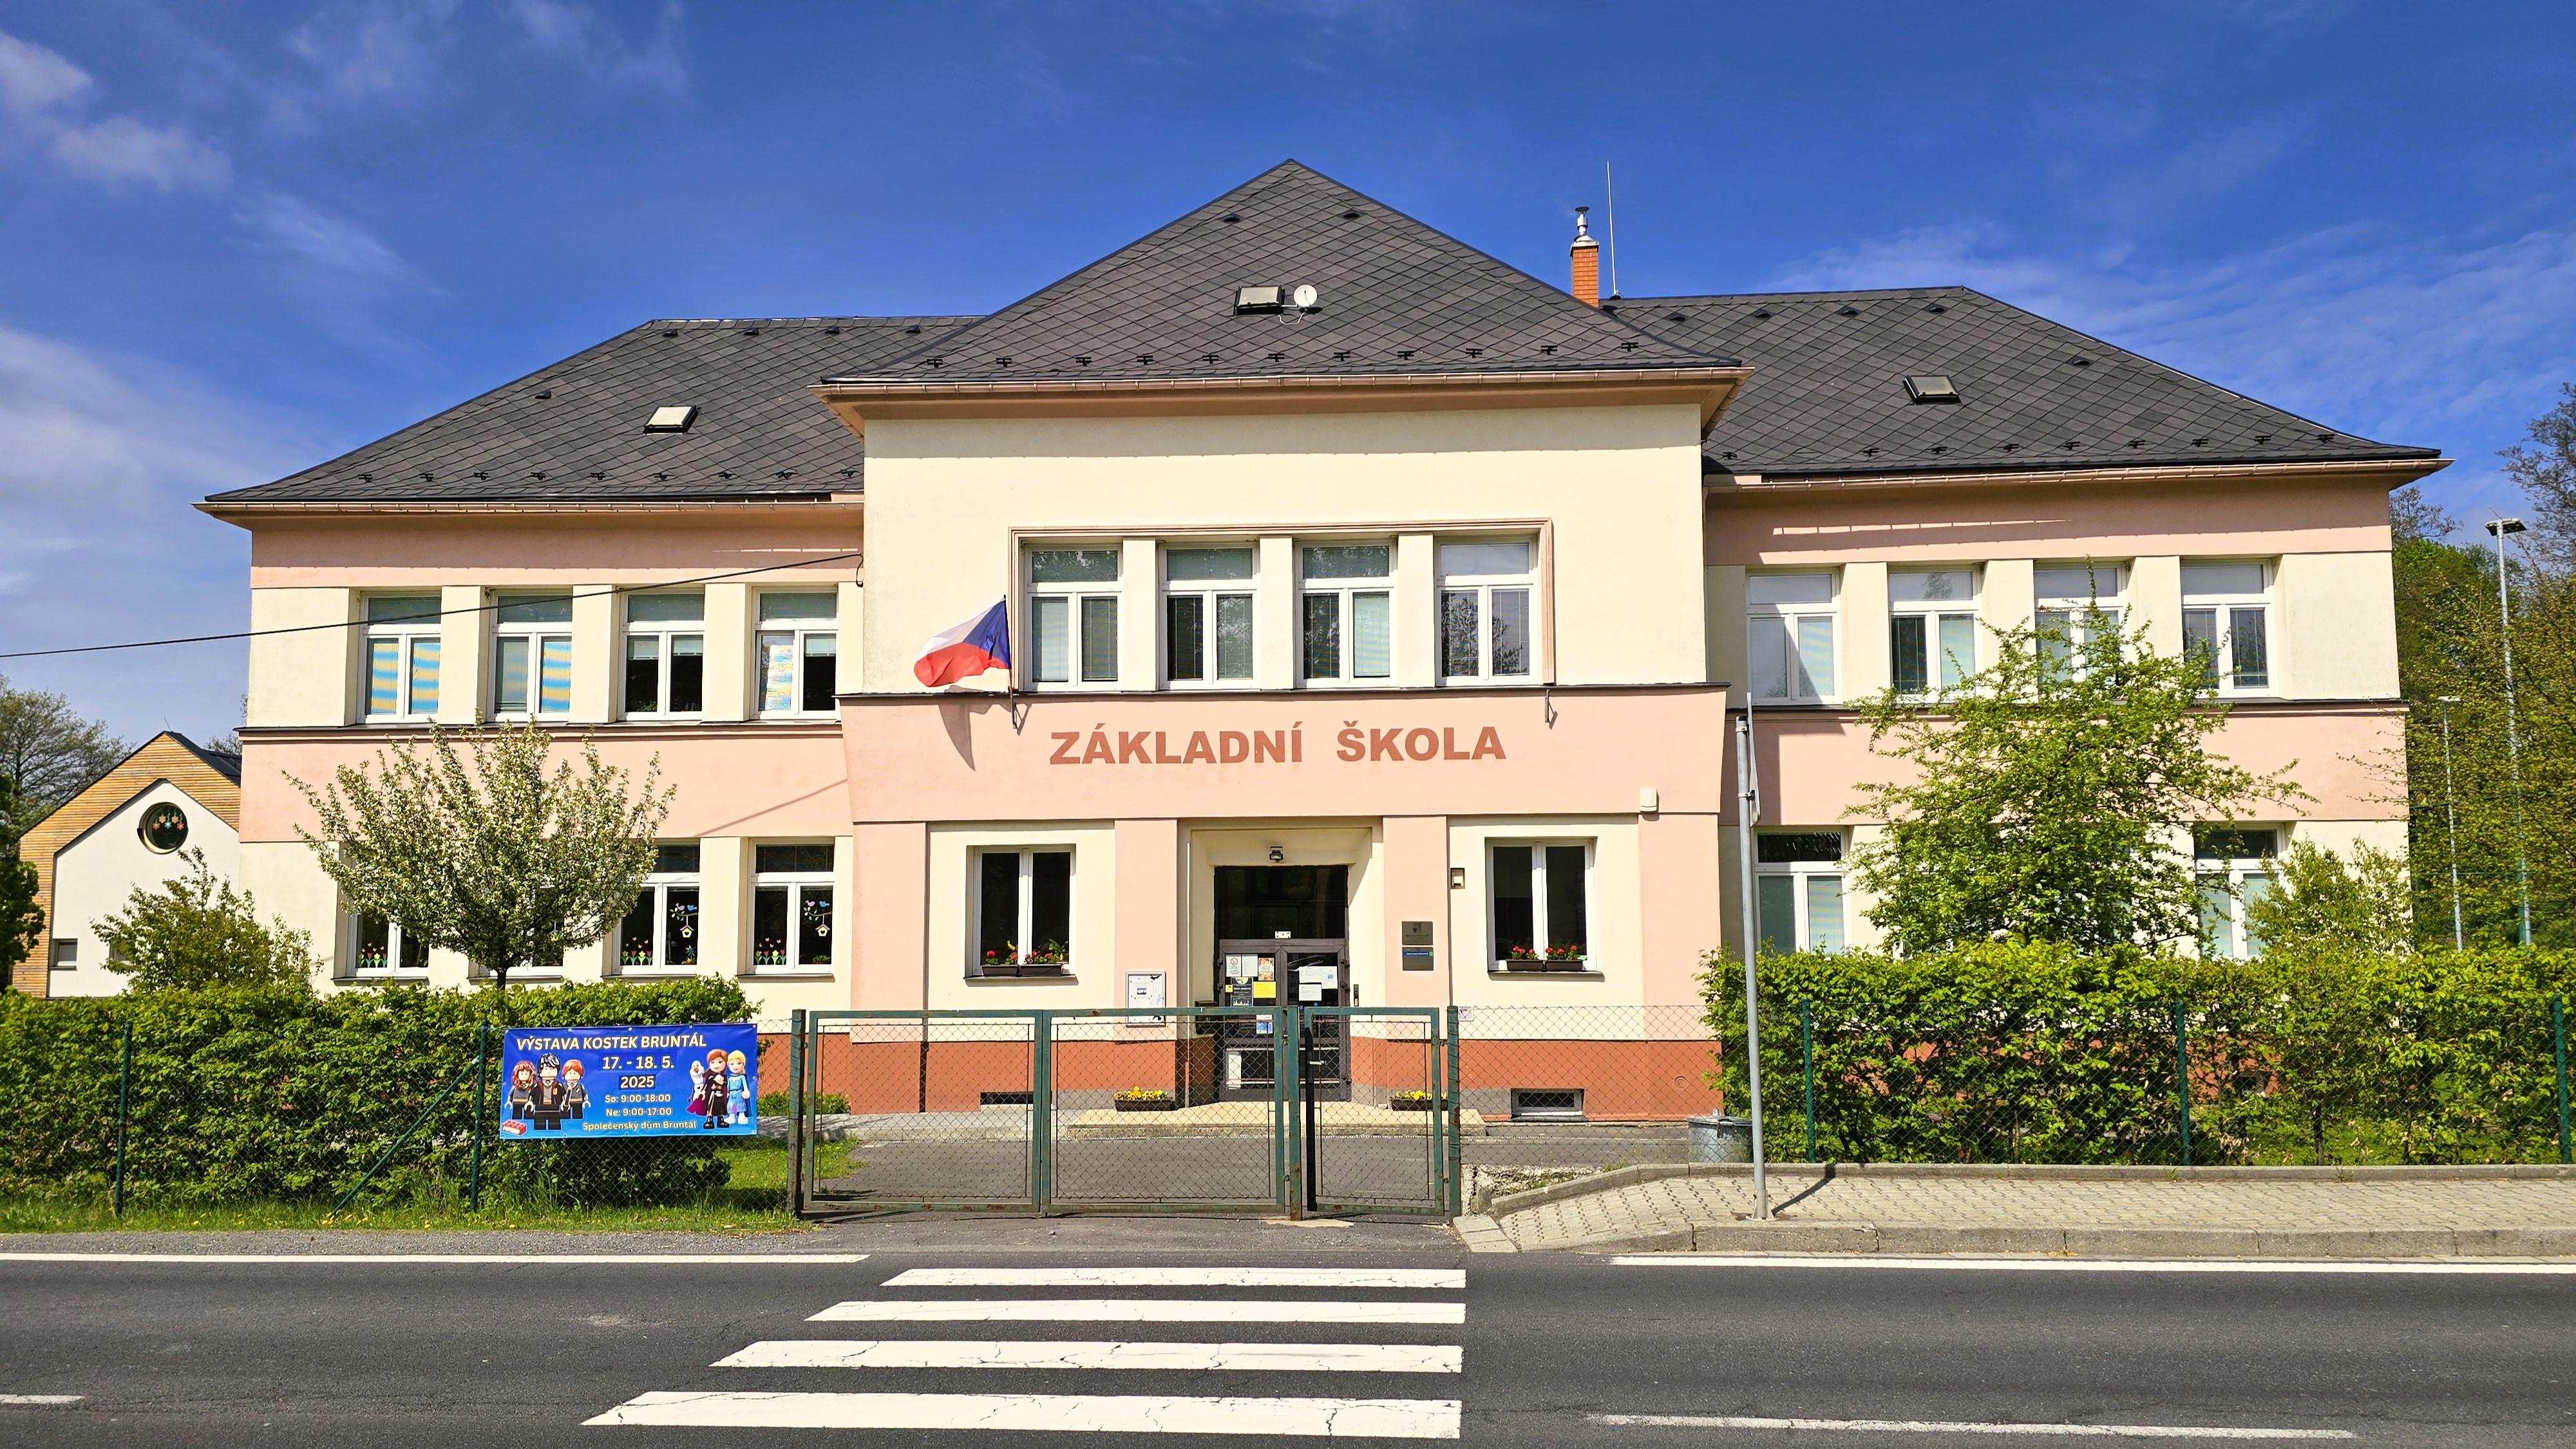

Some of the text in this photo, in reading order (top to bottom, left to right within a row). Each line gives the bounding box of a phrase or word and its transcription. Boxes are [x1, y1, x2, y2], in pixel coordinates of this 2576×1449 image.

[1050, 720, 1507, 765] ZÁKLADNÍ ŠKOLA
[516, 1032, 707, 1050] VÝSTAVA KOSTEK BRUNTÁL
[602, 1056, 622, 1070] 17.
[636, 1056, 658, 1069] 18.
[661, 1056, 674, 1069] 5.
[620, 1075, 654, 1088] 2025
[621, 1094, 671, 1103] 9:00-18:00
[623, 1107, 672, 1116] 9:00-17:00
[583, 1119, 697, 1132] Společenský dům Bruntál
